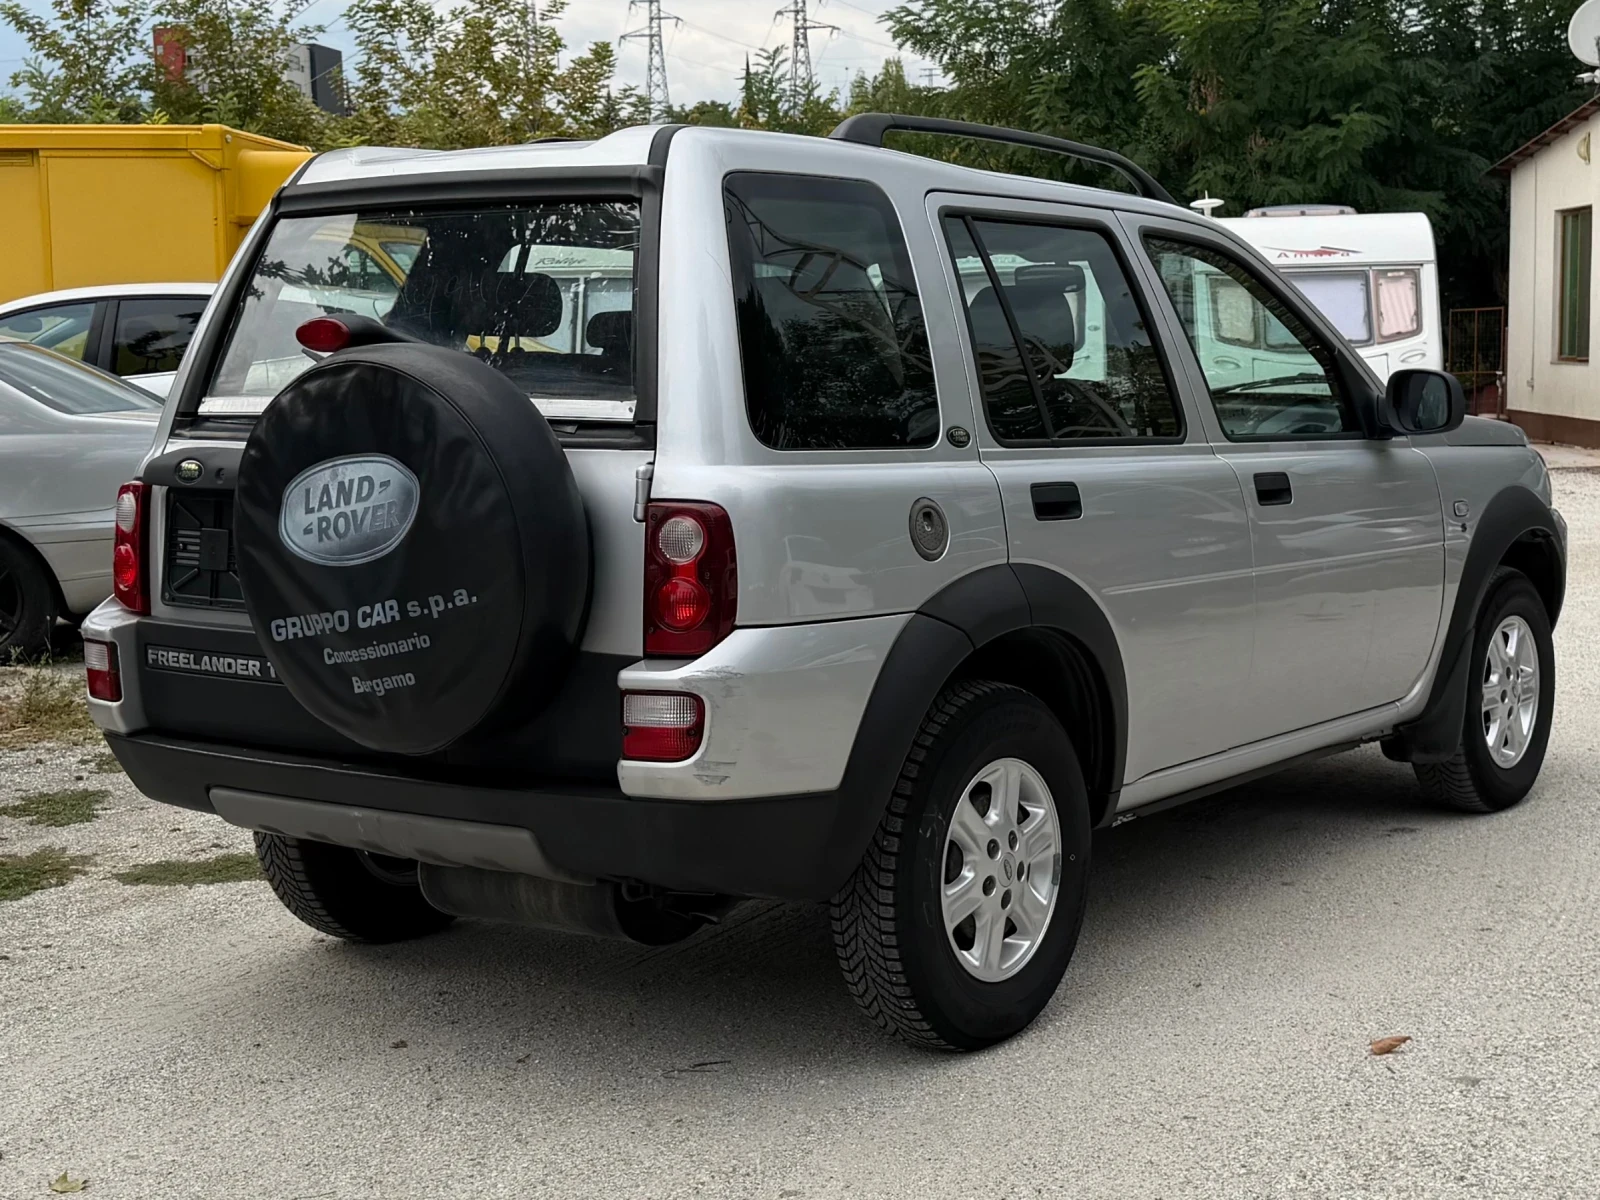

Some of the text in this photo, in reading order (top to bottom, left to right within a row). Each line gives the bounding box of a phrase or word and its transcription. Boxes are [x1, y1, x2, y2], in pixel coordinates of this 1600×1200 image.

[270, 588, 478, 641] GRUPPO CAR s.p.a.
[147, 649, 262, 678] FREELANDER
[323, 633, 431, 665] Concessionario
[351, 673, 416, 696] Bergamo
